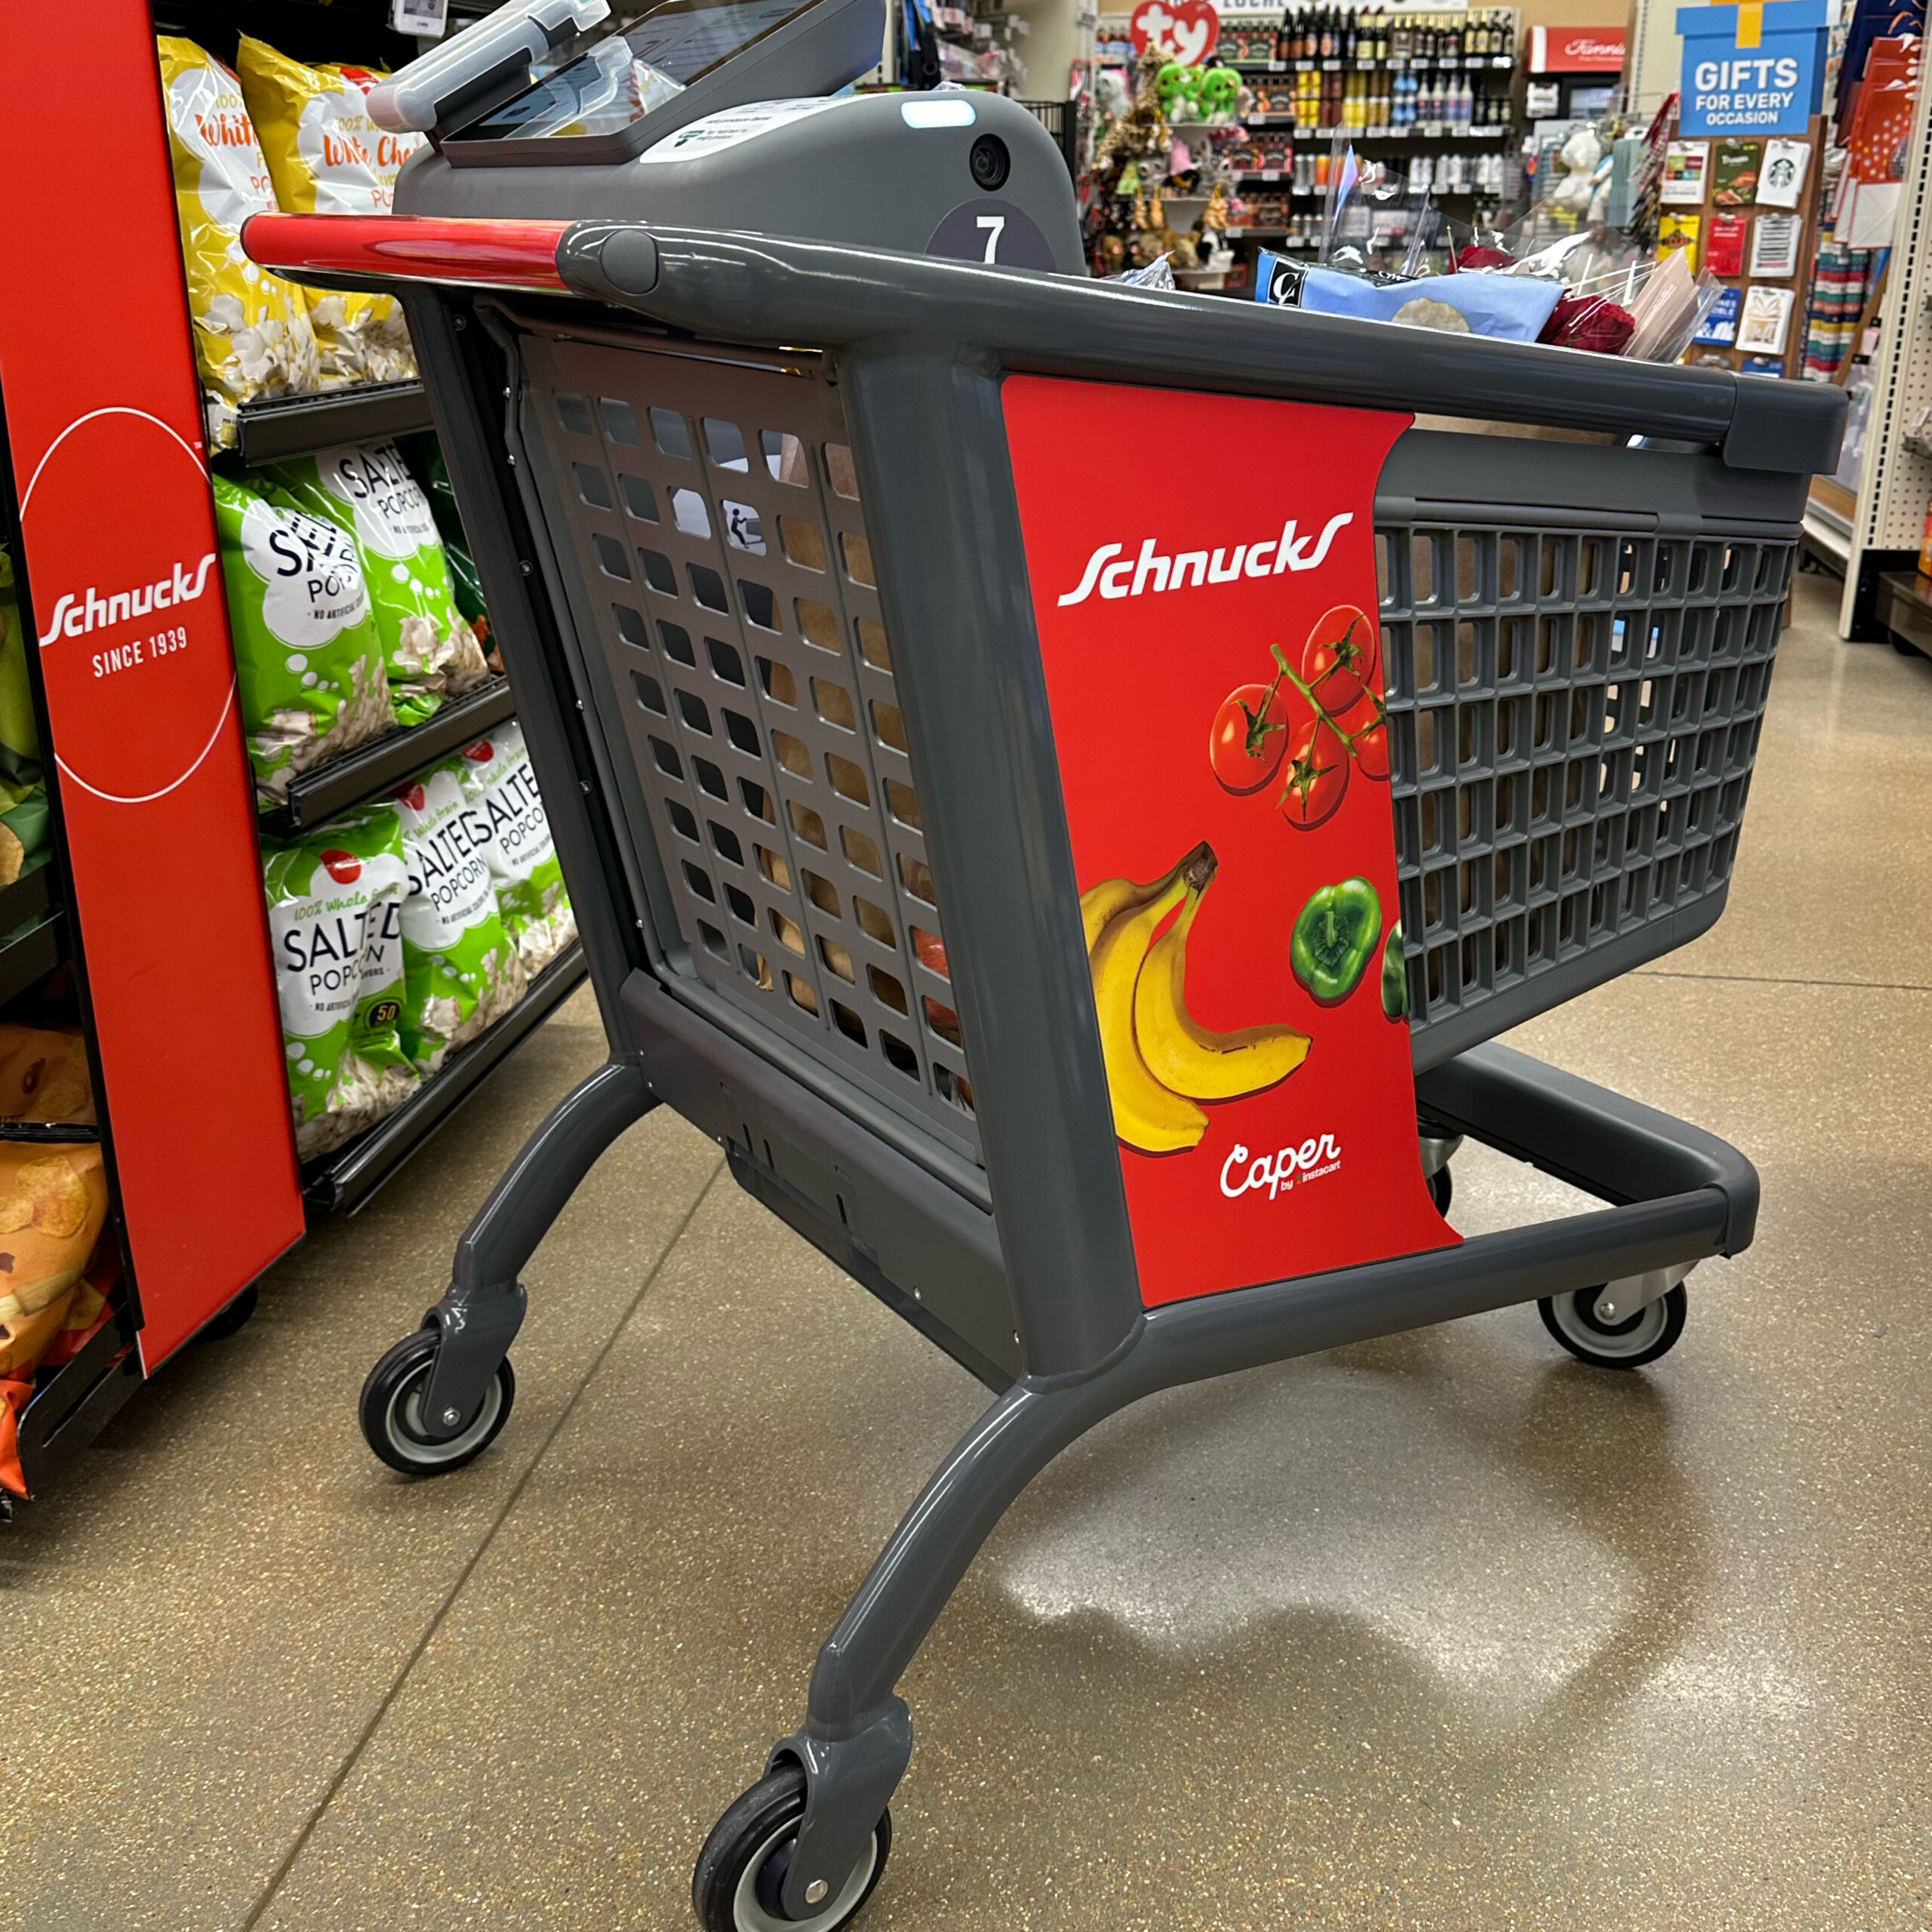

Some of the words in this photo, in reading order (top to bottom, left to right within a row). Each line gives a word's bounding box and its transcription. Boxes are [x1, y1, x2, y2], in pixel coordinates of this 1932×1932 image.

[1695, 57, 1798, 91] GIFTS
[337, 115, 362, 132] 00%
[1695, 94, 1730, 111] FOR
[1734, 91, 1794, 110] EVERY
[1706, 111, 1780, 126] OCCASION
[977, 216, 1004, 264] 7
[339, 444, 412, 499] SALTE
[1057, 512, 1353, 607] Schnucks
[38, 552, 217, 648] Schnucks
[92, 640, 144, 678] SINCE
[149, 626, 188, 659] 1939
[469, 763, 539, 844] SALTE
[500, 807, 544, 854] POPCO
[430, 854, 488, 912] POPCORN
[294, 899, 323, 921] 100%
[377, 1004, 397, 1021] 50
[1220, 1134, 1342, 1201] Caper
[1281, 1180, 1294, 1192] by
[1302, 1160, 1341, 1183] instacart
